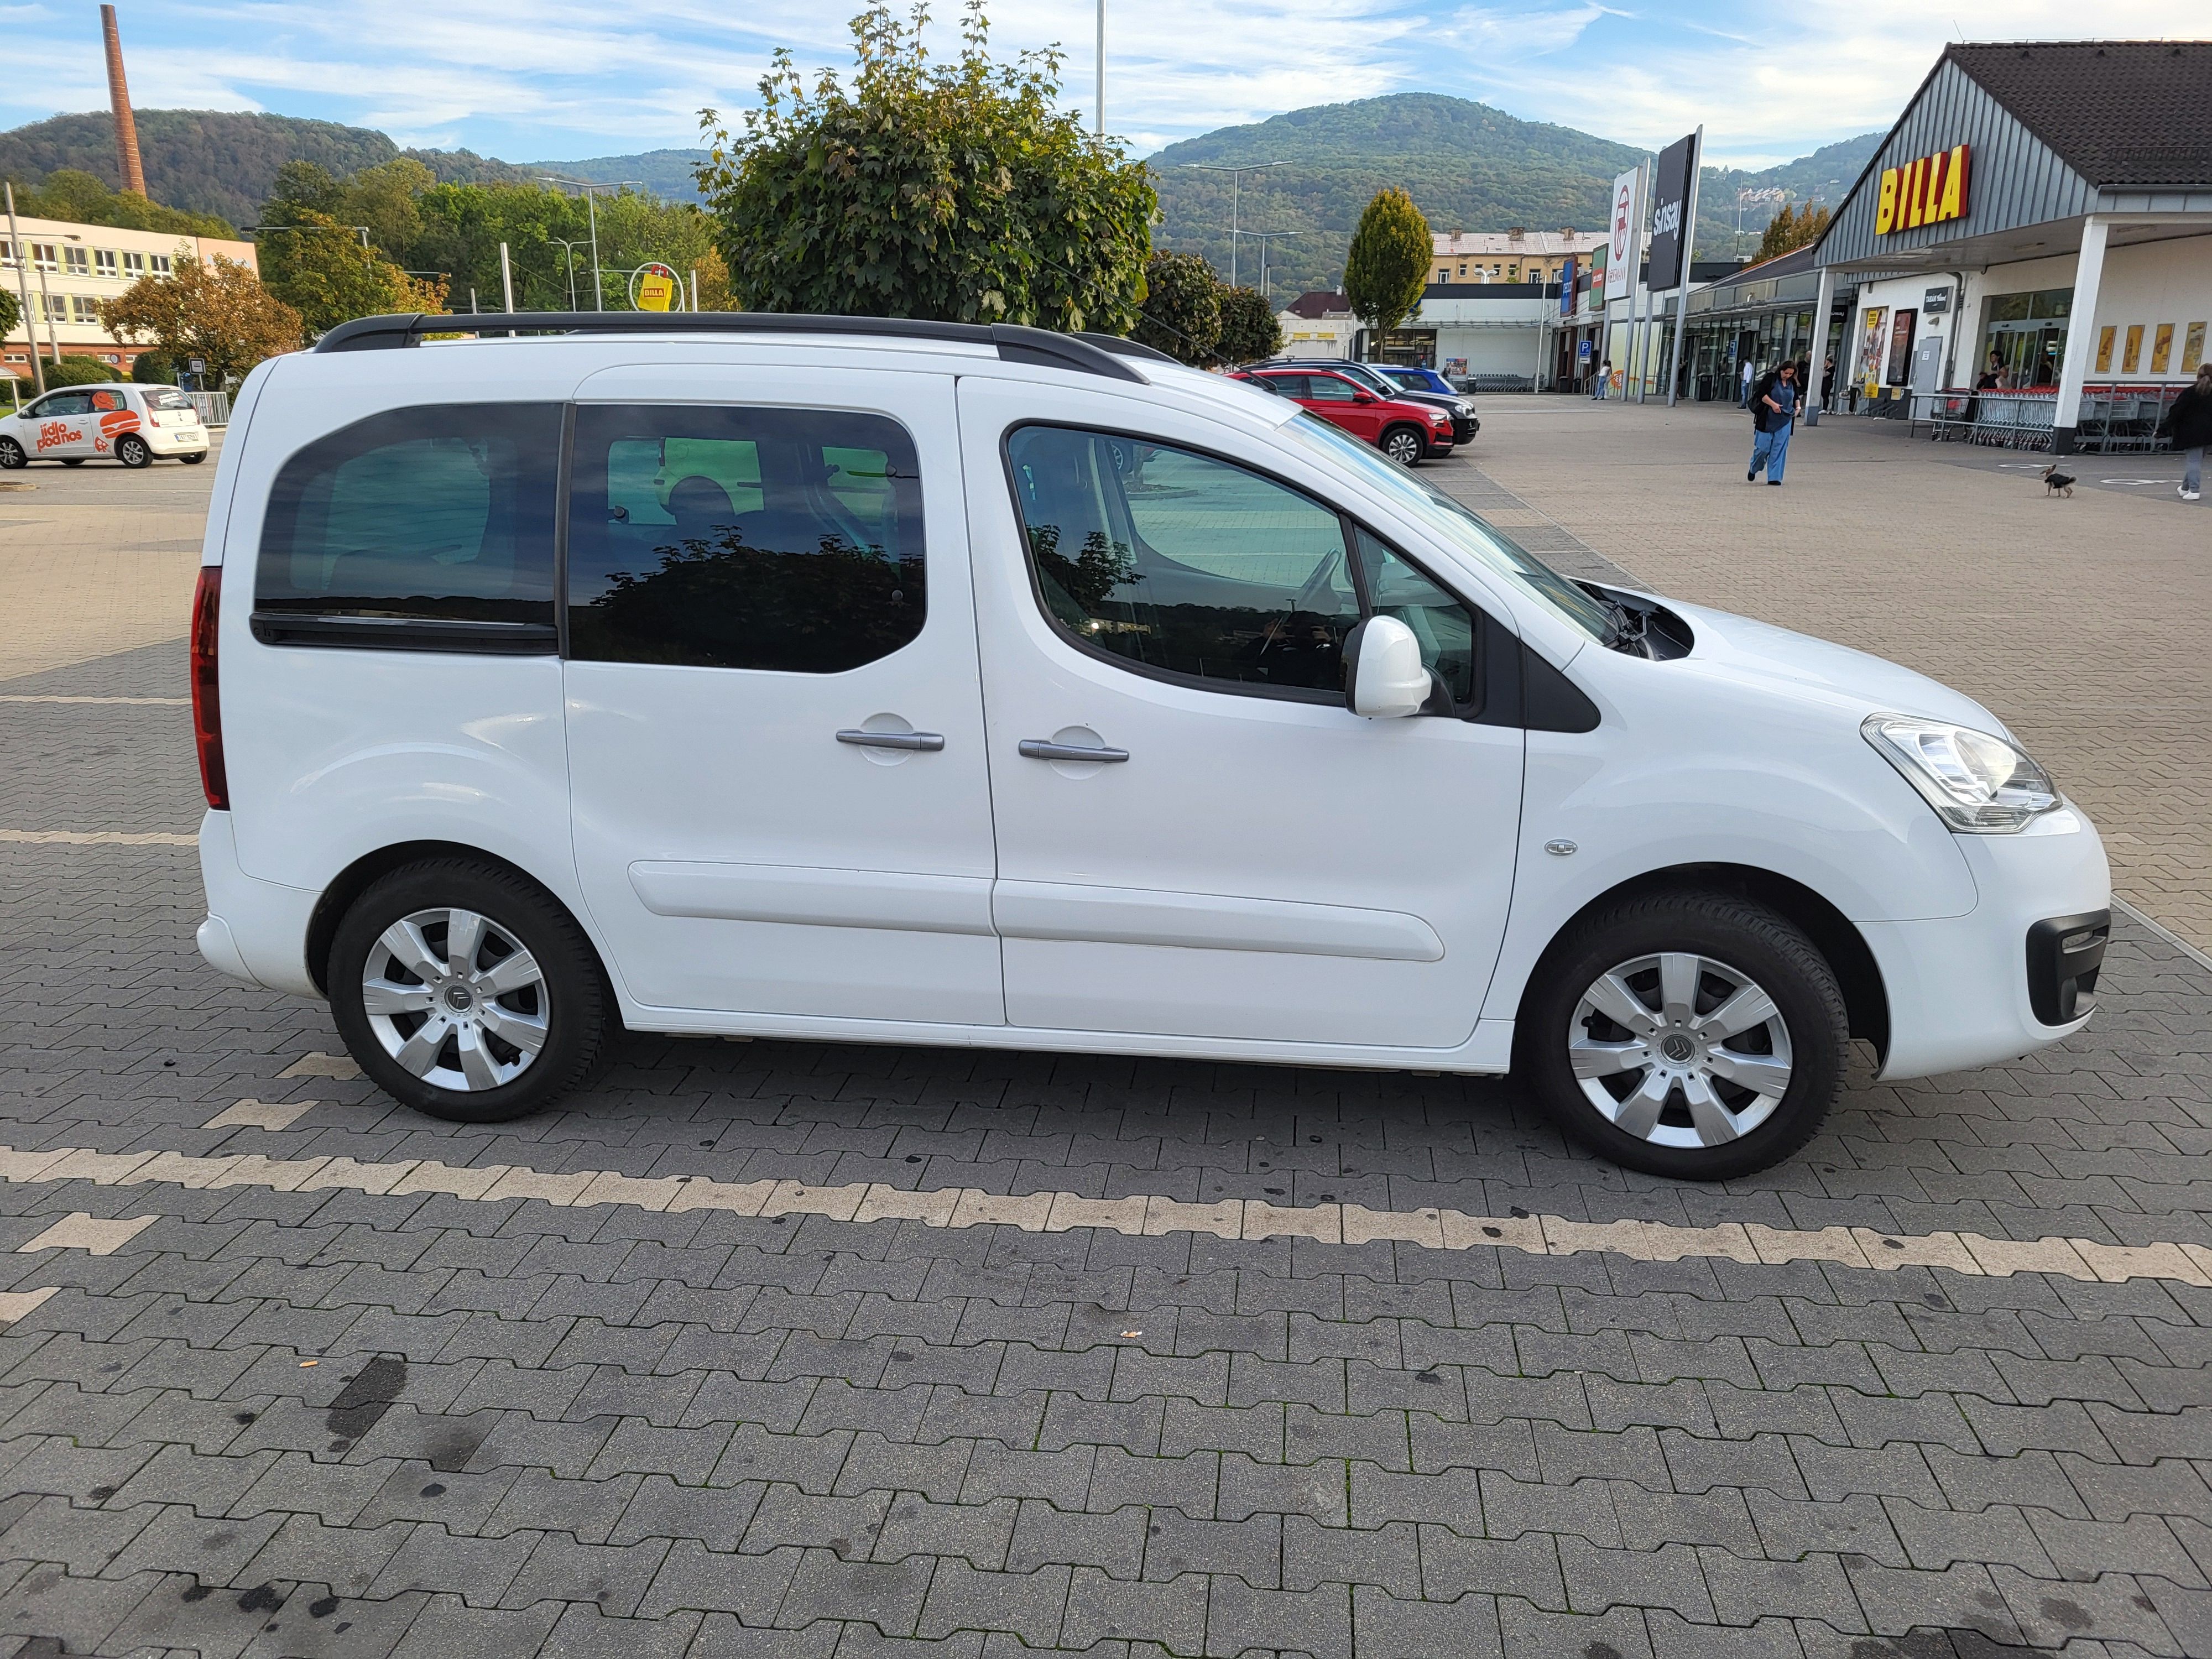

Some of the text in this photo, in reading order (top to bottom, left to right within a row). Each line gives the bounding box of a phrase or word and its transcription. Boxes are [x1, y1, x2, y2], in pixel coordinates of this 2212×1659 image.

[1875, 144, 1969, 235] BILLA
[1653, 197, 1681, 241] sinsay
[1582, 342, 1589, 352] P
[40, 421, 67, 441] jídlo
